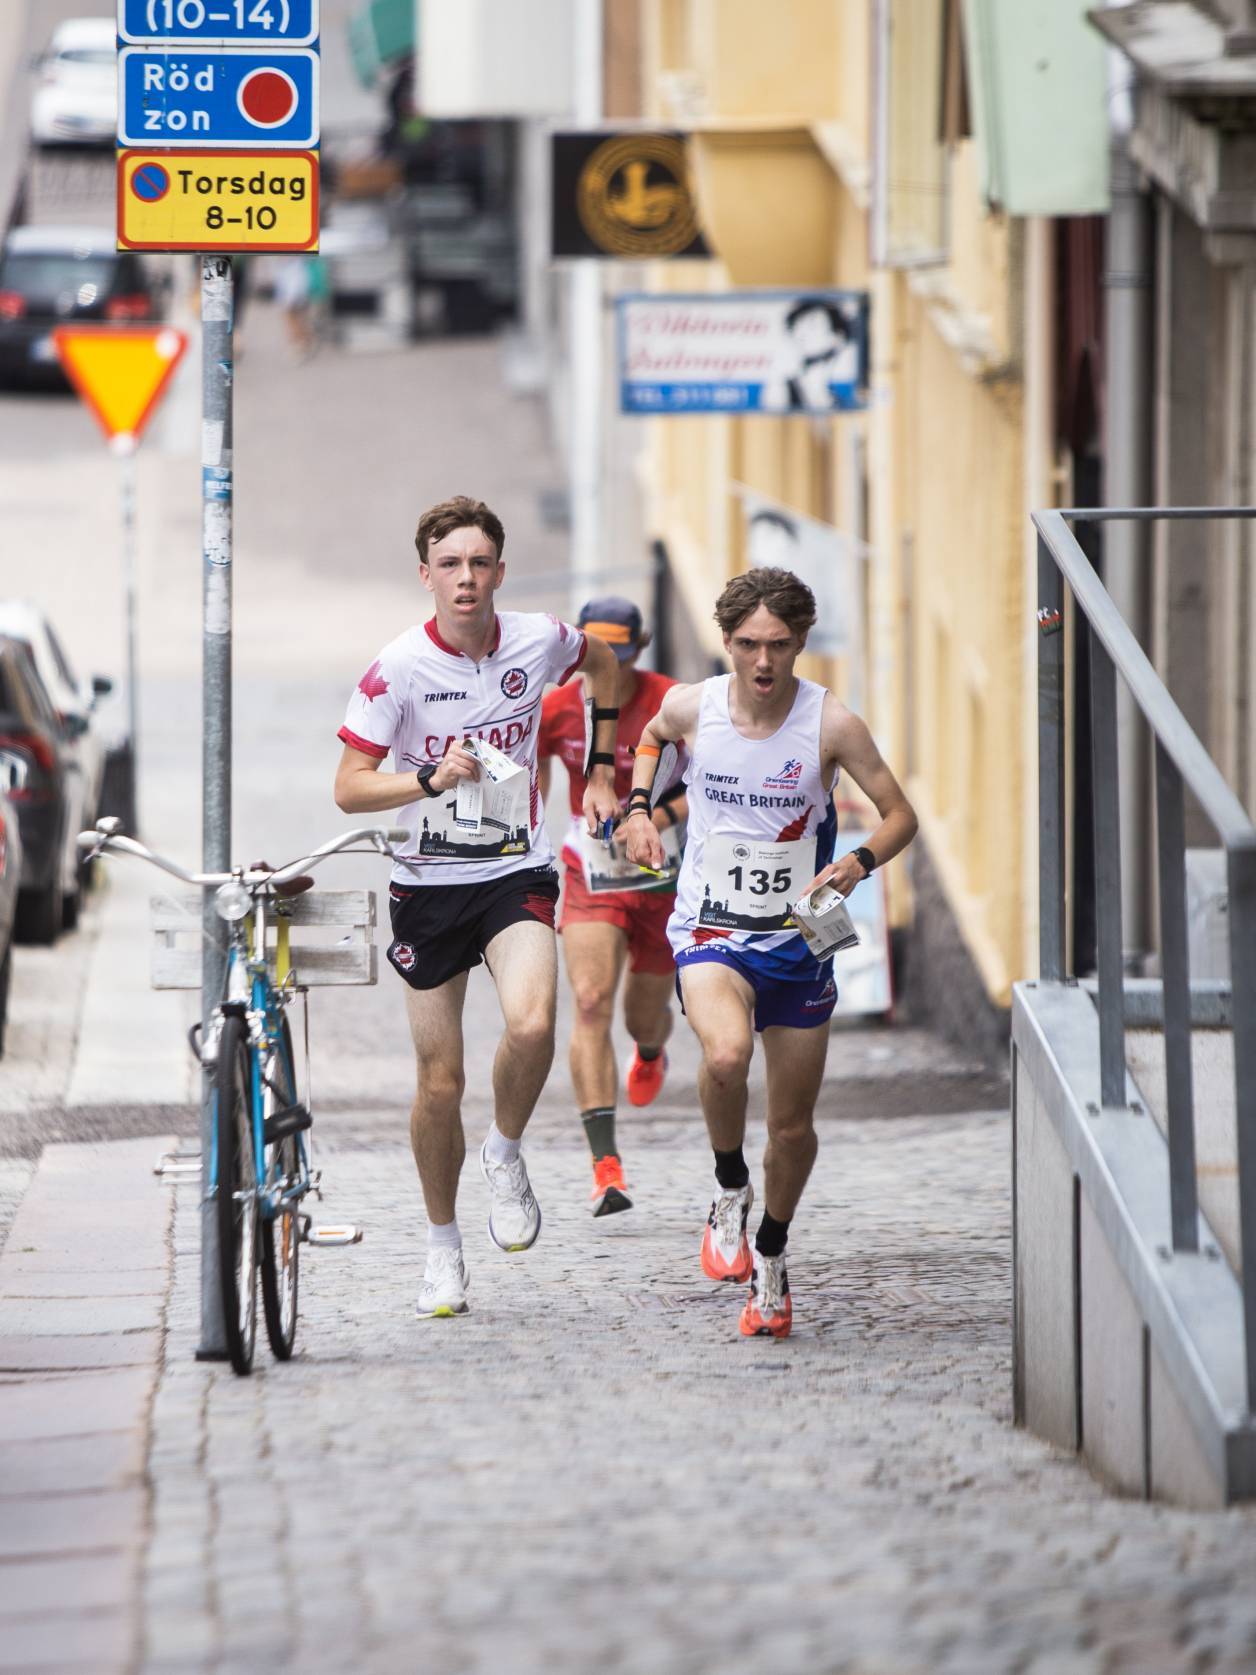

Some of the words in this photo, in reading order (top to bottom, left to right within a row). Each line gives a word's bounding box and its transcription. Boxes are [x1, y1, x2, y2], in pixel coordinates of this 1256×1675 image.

[146, 0, 290, 33] (10-14)
[144, 63, 214, 91] Röd
[144, 109, 210, 130] zon
[178, 170, 305, 200] Torsdag
[206, 206, 277, 230] 8-10
[424, 691, 468, 703] TRIMTEX
[705, 772, 740, 785] TRIMTEX
[705, 787, 745, 806] GREAT
[749, 794, 806, 809] BRITAIN
[728, 866, 792, 895] 135
[703, 916, 738, 926] KARLSKRONA
